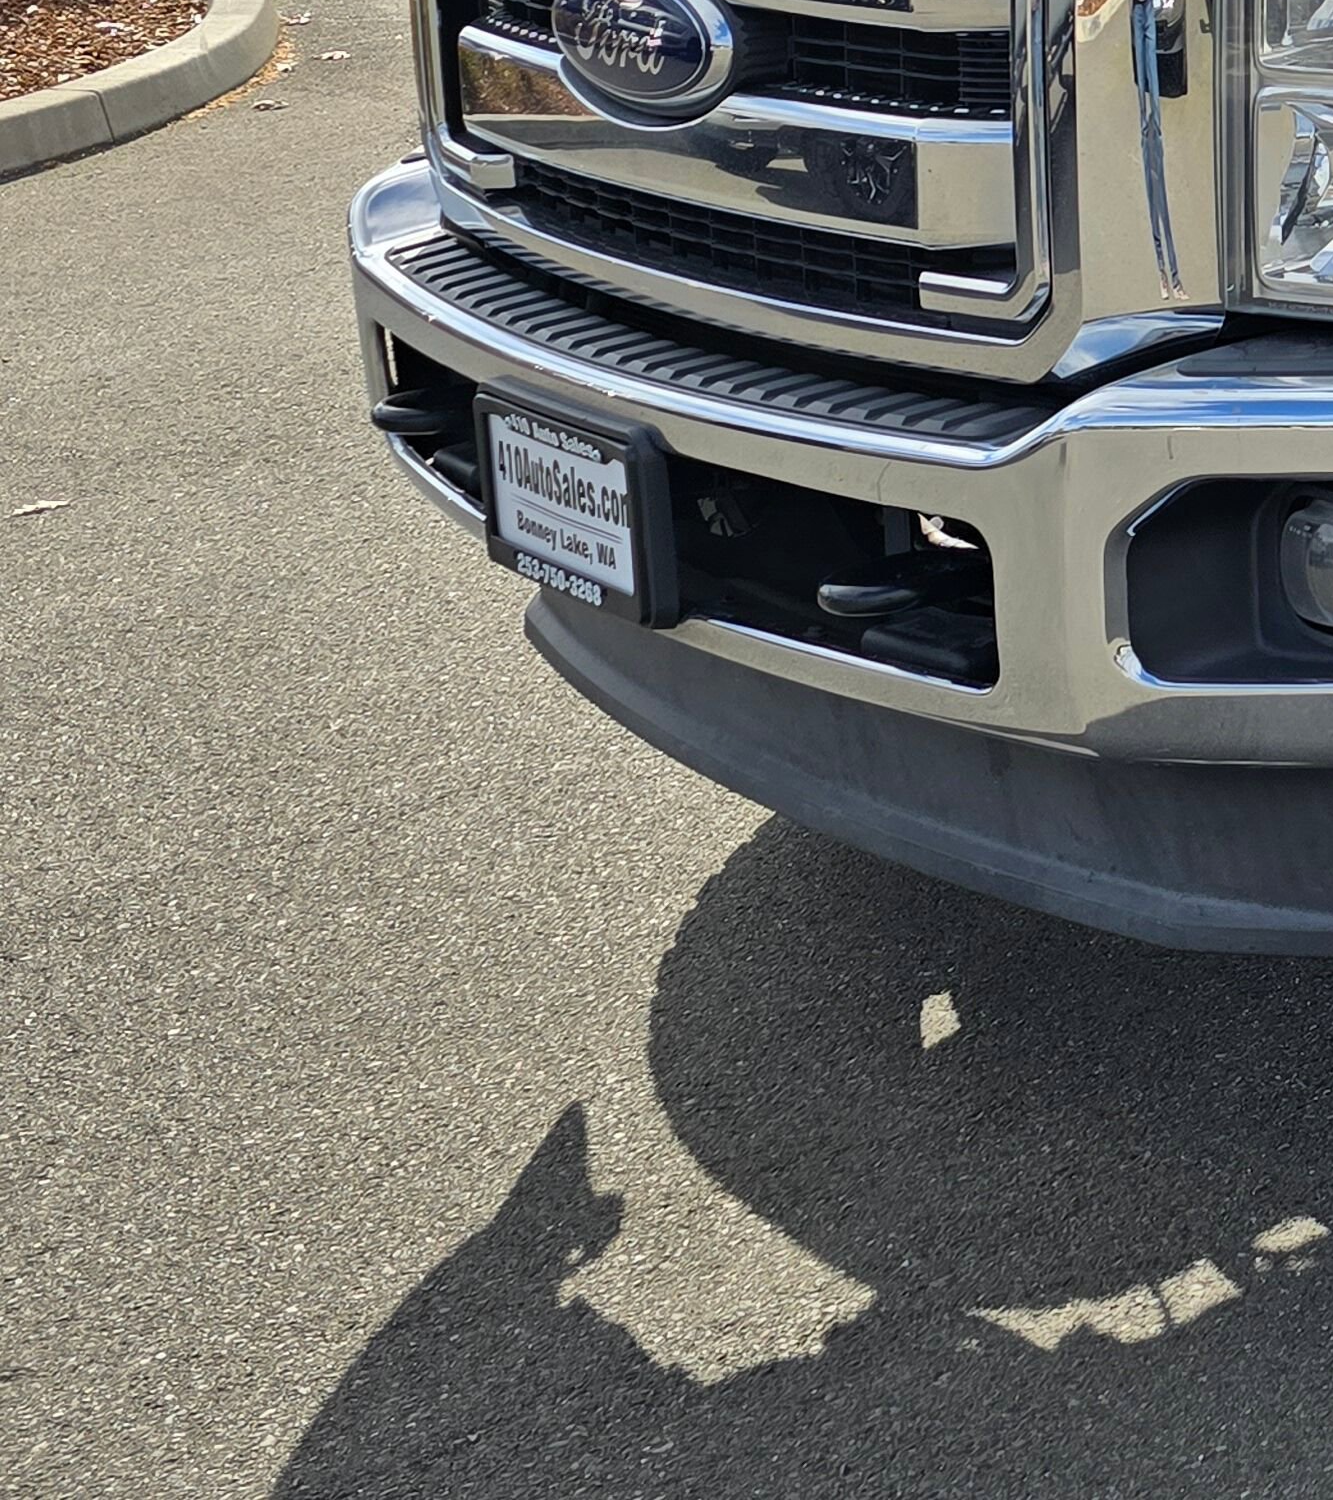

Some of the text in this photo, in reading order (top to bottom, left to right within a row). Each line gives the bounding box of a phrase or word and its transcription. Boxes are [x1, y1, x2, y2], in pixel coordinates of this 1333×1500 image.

[516, 509, 617, 570] Bonney Lake, WA
[517, 552, 602, 606] 253-750-3268
